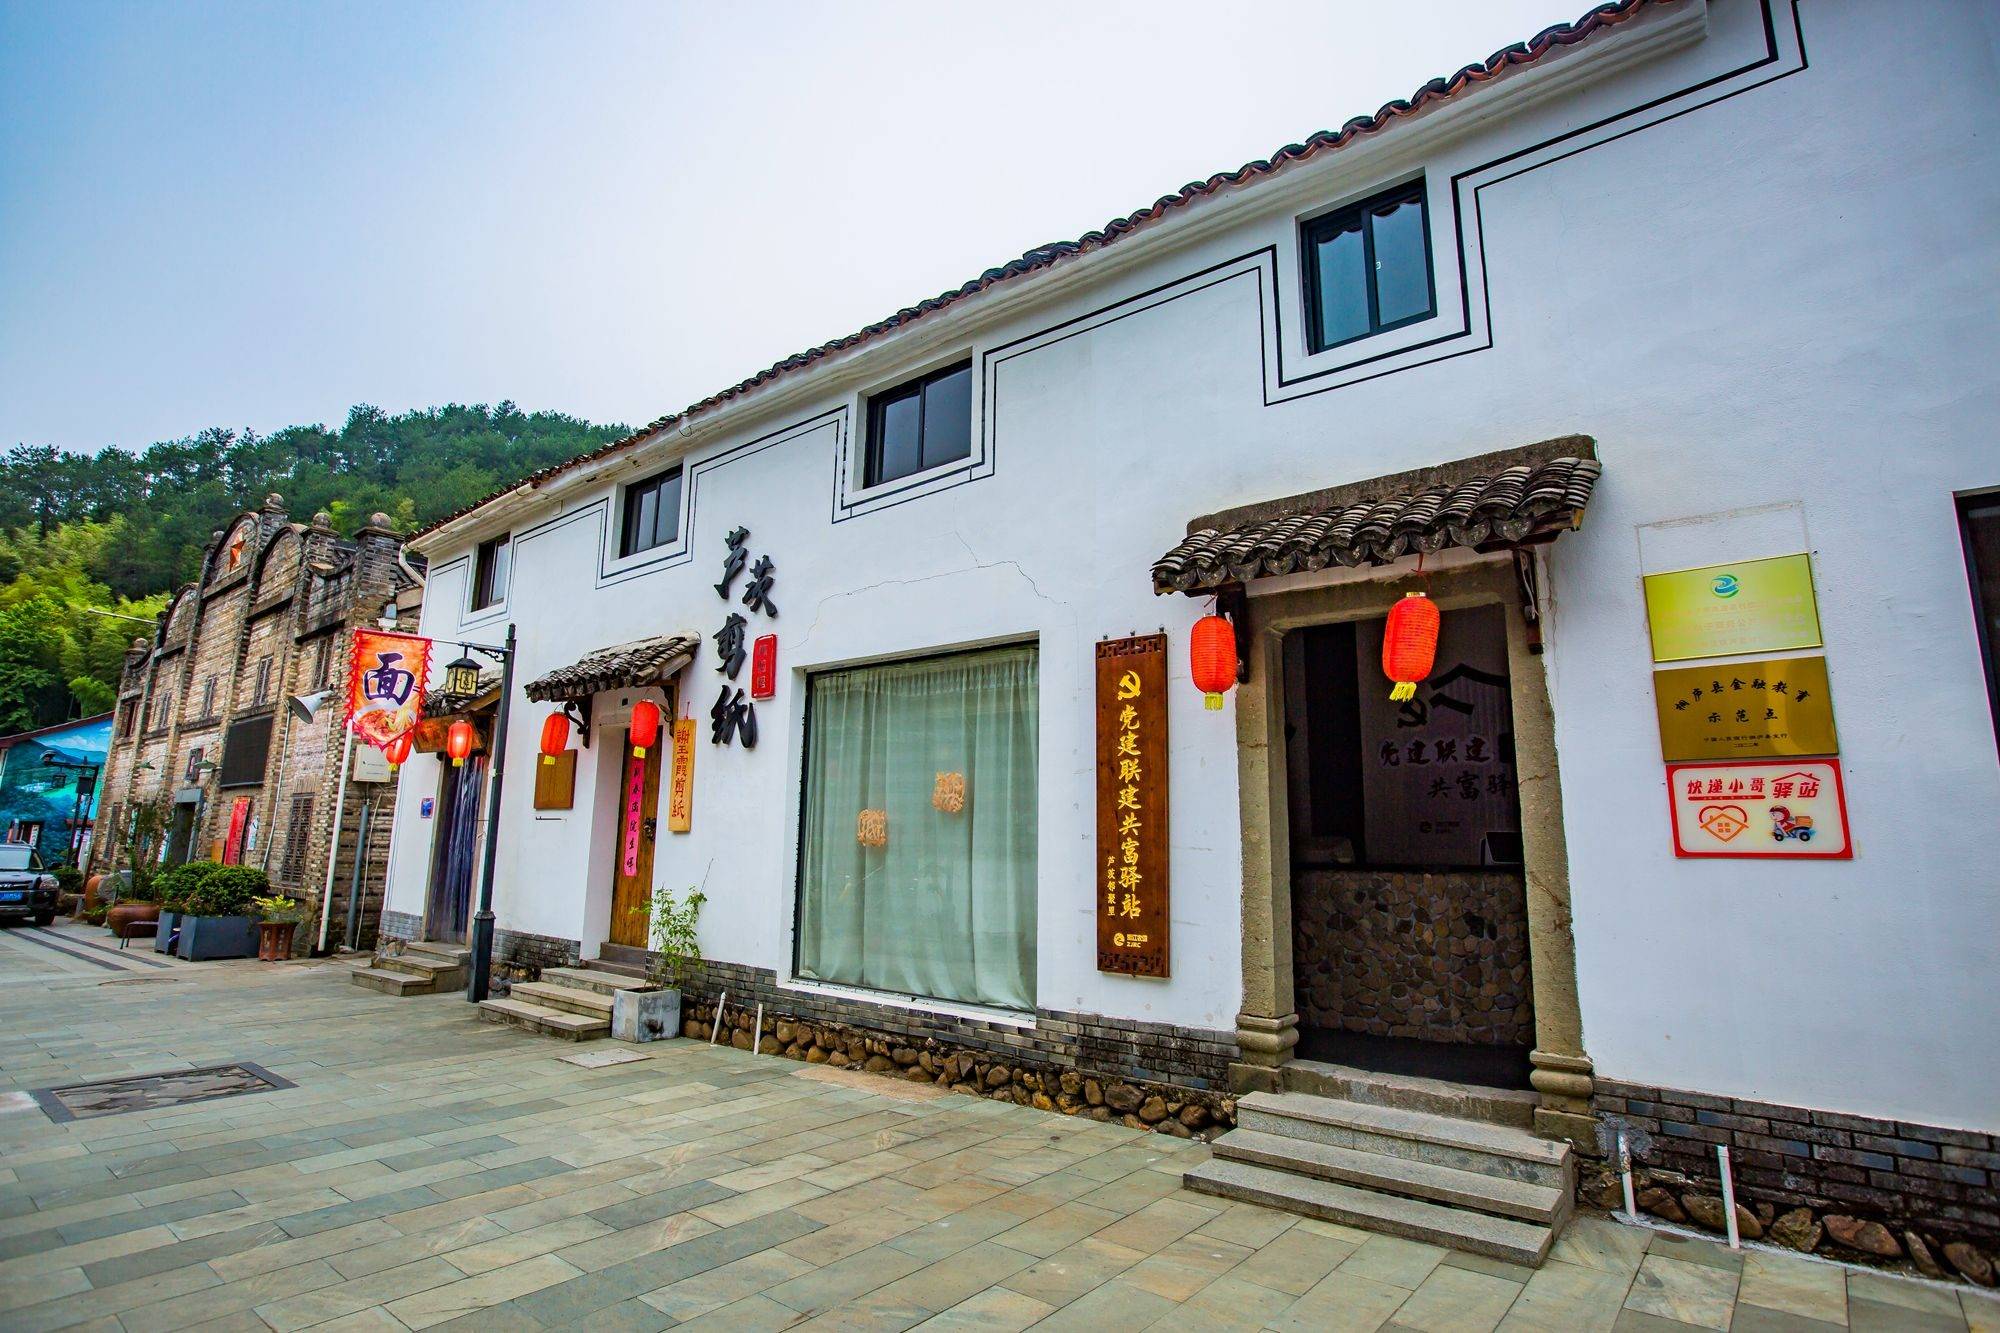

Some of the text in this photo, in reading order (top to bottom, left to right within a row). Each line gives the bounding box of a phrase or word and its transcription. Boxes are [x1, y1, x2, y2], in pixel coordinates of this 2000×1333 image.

[364, 653, 414, 705] 面
[1674, 678, 1810, 711] 桐庐县金融教育
[1708, 708, 1778, 723] 示范点
[1118, 704, 1142, 920] 党建联建共富驿站
